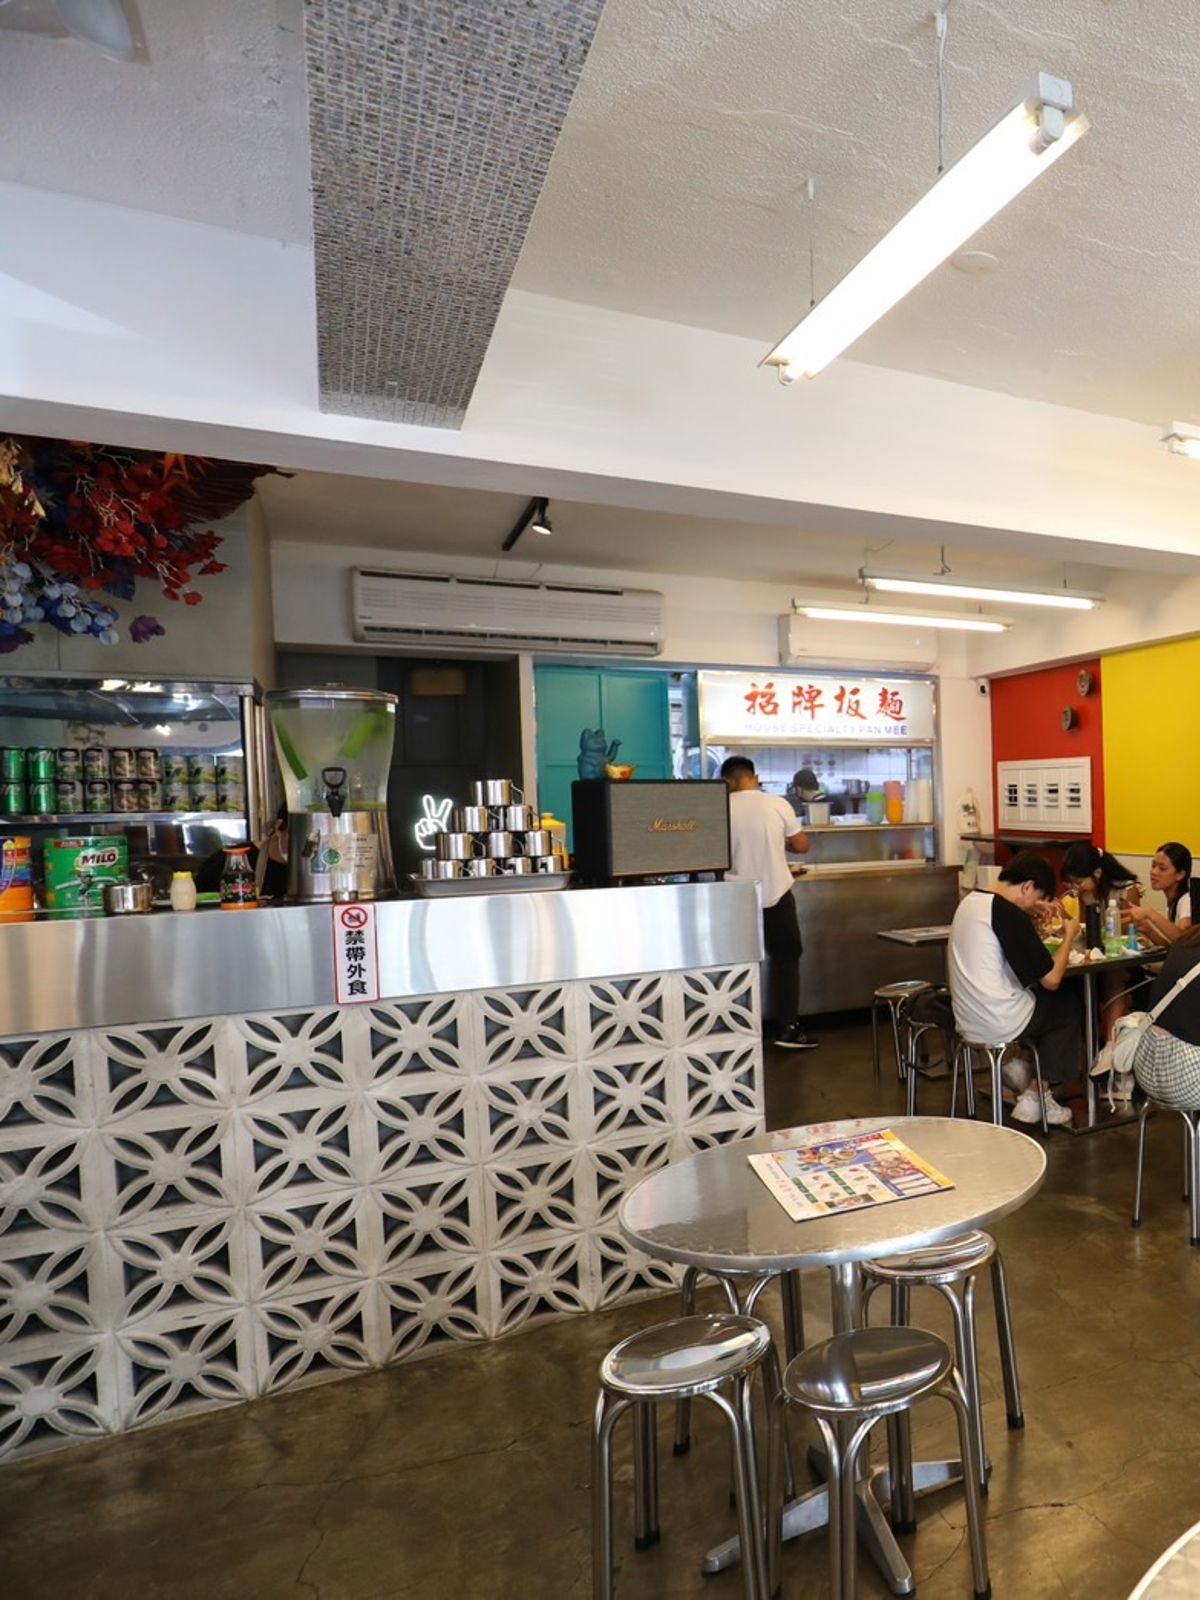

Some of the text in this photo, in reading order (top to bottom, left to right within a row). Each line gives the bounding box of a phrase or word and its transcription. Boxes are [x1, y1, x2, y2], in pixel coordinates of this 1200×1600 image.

[744, 682, 907, 721] 招牌板麵
[792, 724, 855, 735] SPECIALTY
[859, 726, 881, 735] PAN
[648, 817, 697, 832] Marshall
[82, 852, 116, 865] MILO
[345, 930, 367, 996] 禁帶外食
